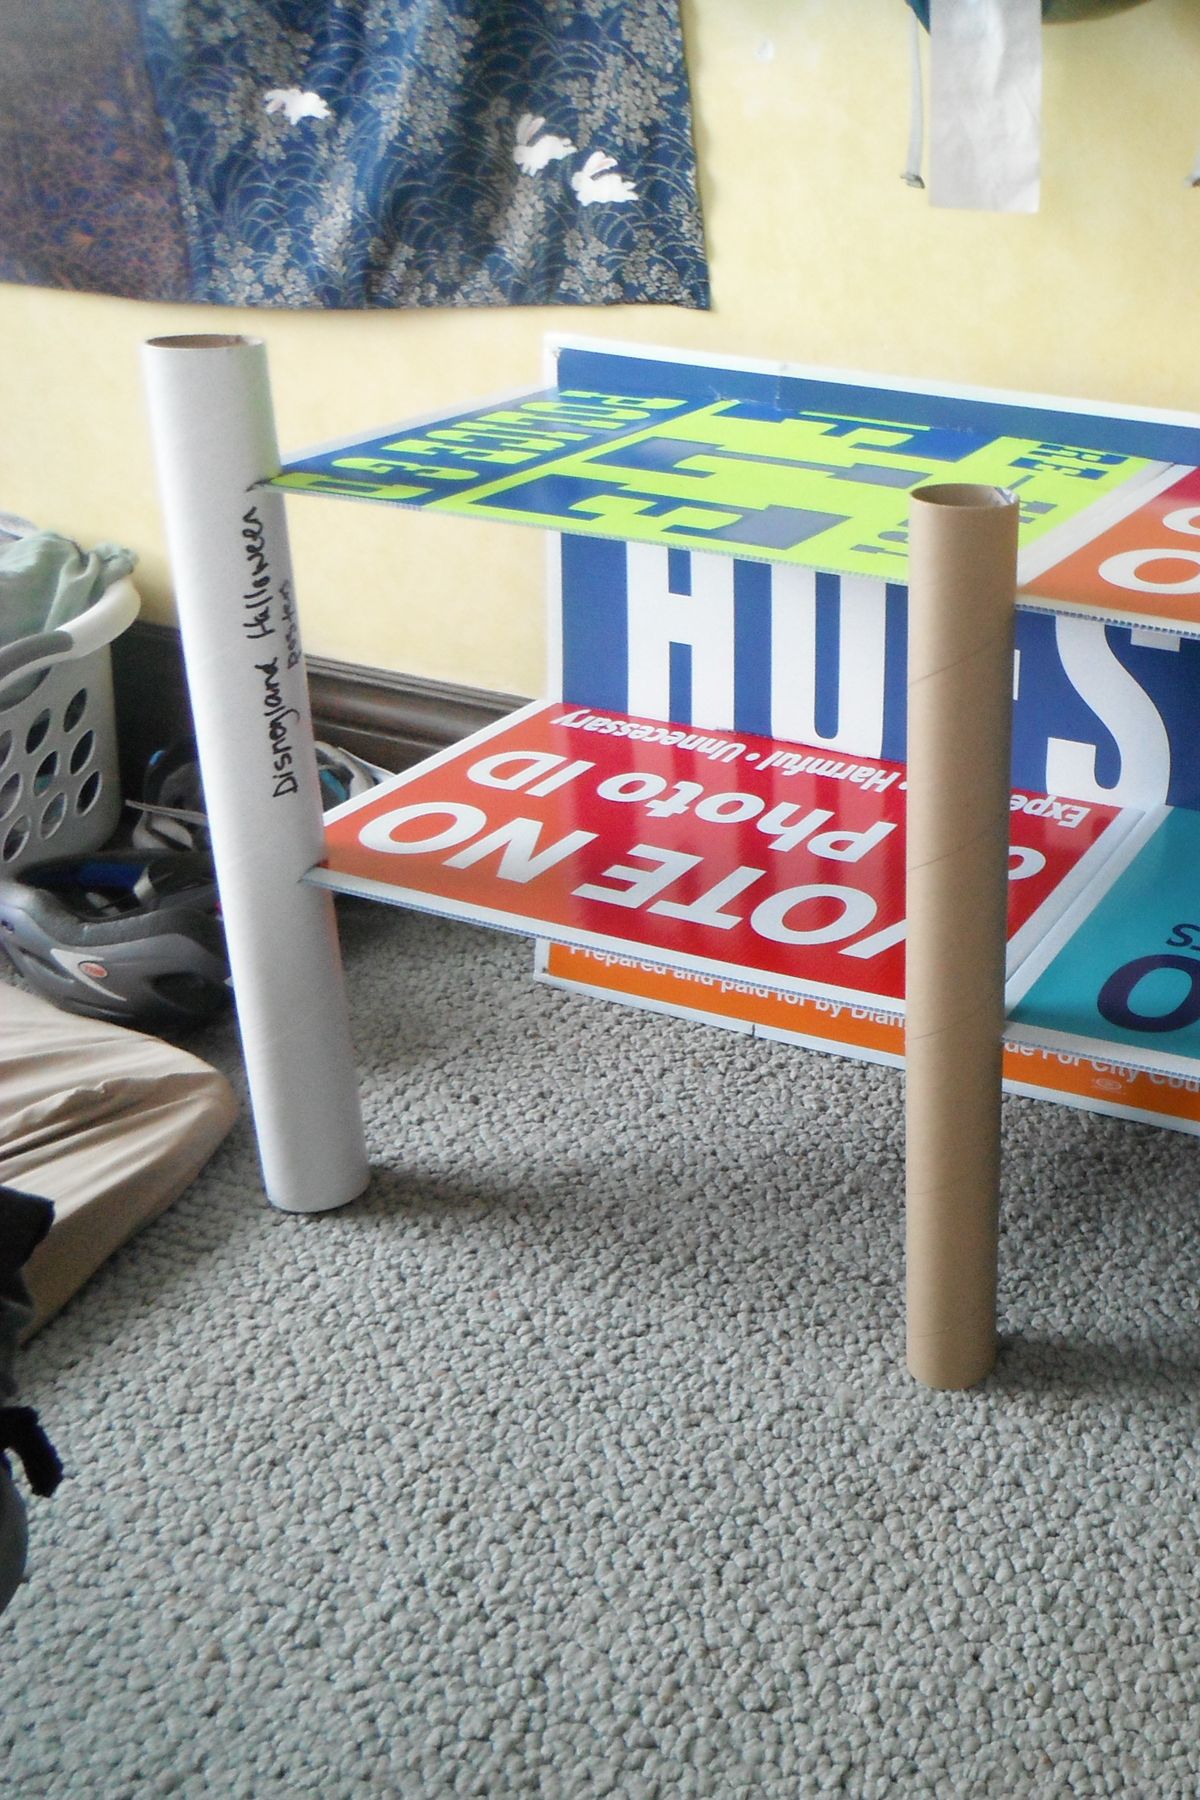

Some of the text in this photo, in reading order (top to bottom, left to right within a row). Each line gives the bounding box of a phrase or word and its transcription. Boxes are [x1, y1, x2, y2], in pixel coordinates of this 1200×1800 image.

[380, 390, 688, 465] POLICE
[241, 506, 275, 640] Halloween
[551, 707, 747, 765] Unnecessary
[764, 750, 901, 792] Harmful
[467, 750, 576, 798] ID
[358, 800, 597, 883] NO
[597, 771, 897, 864] Photo
